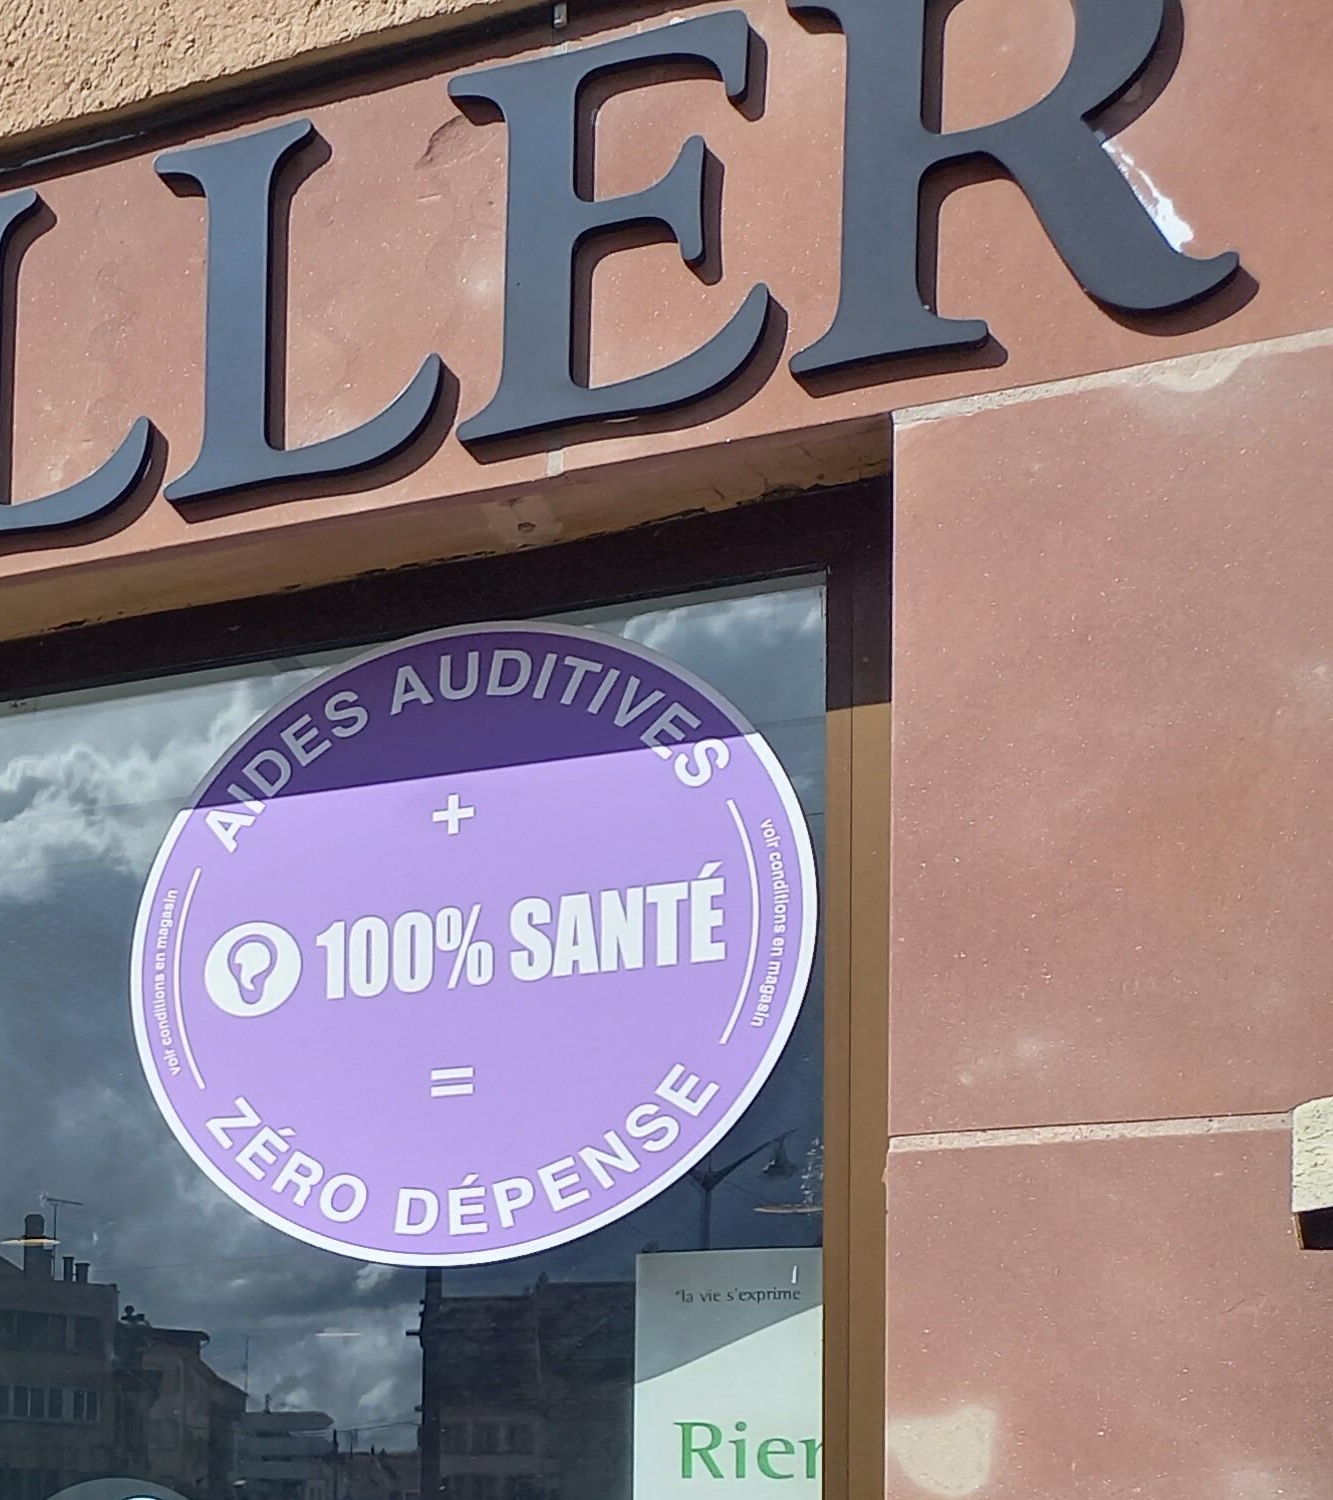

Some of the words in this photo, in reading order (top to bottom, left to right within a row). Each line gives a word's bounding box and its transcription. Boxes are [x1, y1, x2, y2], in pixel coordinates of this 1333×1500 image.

[204, 689, 369, 853] AIDES
[389, 649, 732, 788] AUDITIVES
[760, 818, 780, 848] voir
[156, 888, 179, 949] magasin
[769, 850, 789, 934] conditions
[316, 903, 495, 1000] 100%
[509, 861, 726, 982] SANTÉ
[770, 936, 785, 957] en
[153, 972, 173, 1046] conditions
[750, 960, 781, 1028] magasin
[205, 1097, 367, 1223] ZÉRO
[394, 1062, 720, 1237] DÉPENSE
[700, 1289, 721, 1303] vie
[726, 1286, 801, 1306] s'exprime
